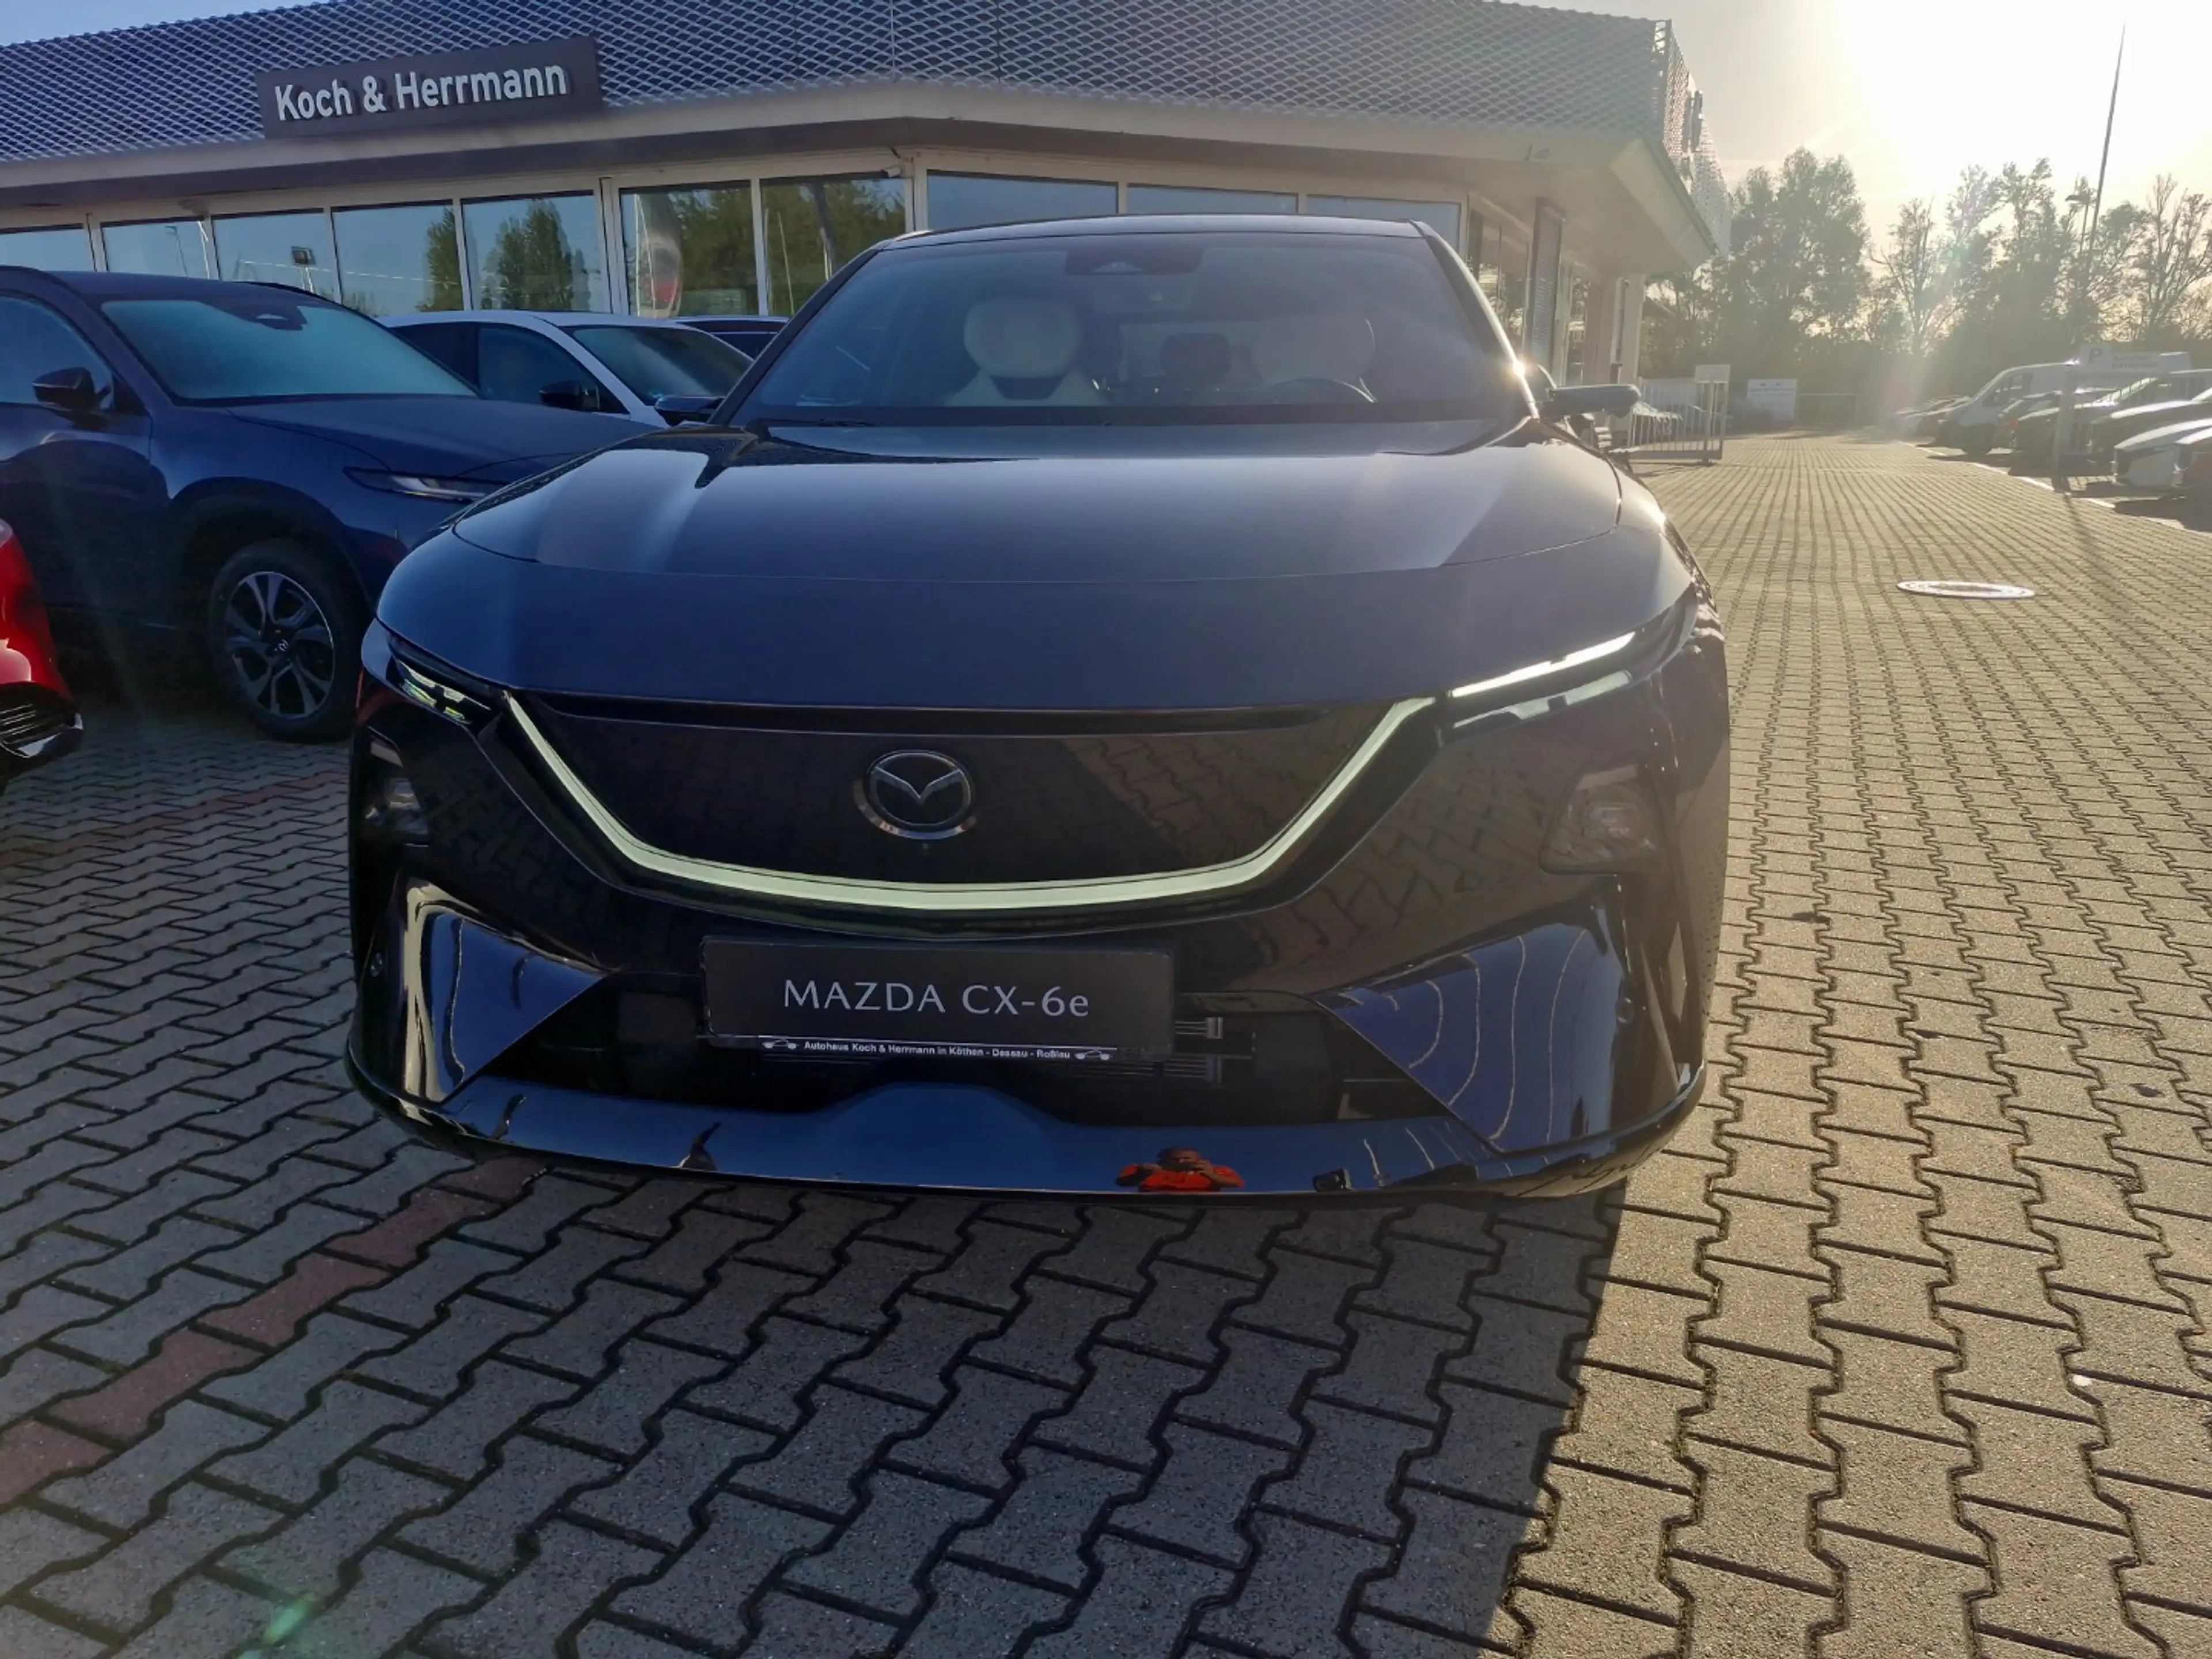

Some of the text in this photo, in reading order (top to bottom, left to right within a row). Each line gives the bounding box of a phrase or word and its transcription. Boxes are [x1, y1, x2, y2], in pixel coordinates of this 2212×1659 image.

[274, 64, 568, 121] Koch & Herrmann
[784, 980, 1089, 1017] MAZDA CX-6e
[804, 1041, 849, 1051] Autohaus
[852, 1043, 877, 1052] Koch
[878, 1044, 886, 1053] &
[888, 1044, 935, 1055] Herrmann
[937, 1046, 947, 1055] in
[949, 1046, 984, 1056] Köthen
[993, 1048, 1028, 1058] Dessau
[1037, 1049, 1070, 1059] Roßlau
